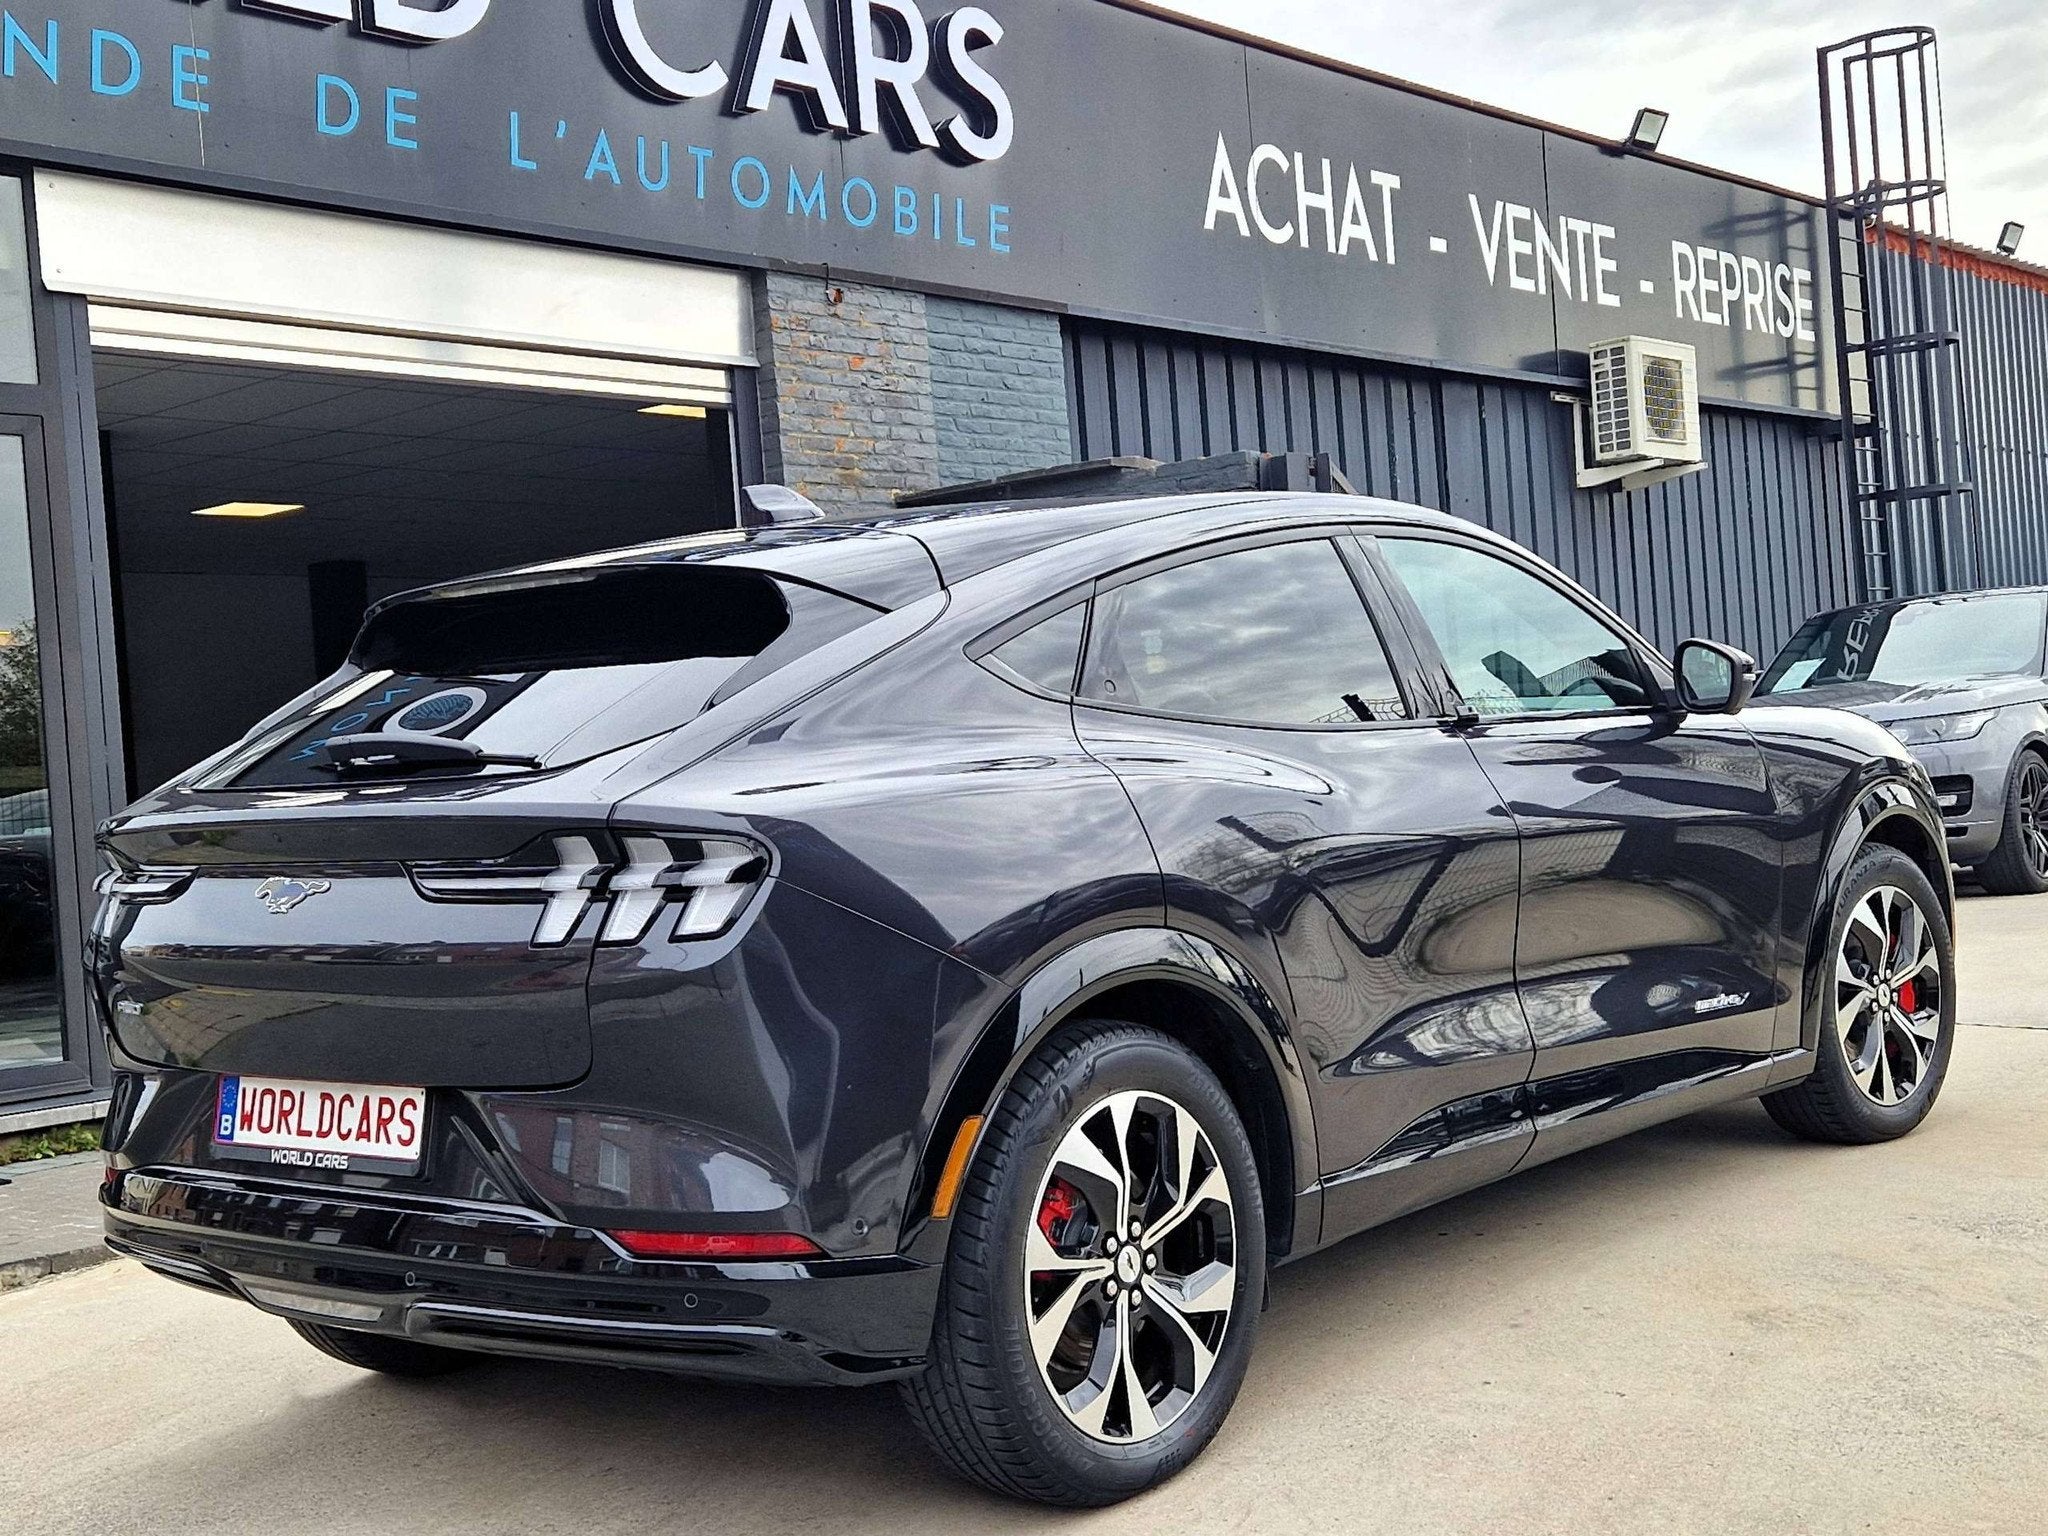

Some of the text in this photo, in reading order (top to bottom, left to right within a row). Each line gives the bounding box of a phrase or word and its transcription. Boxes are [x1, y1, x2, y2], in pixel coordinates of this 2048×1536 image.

[316, 74, 418, 149] DE
[1204, 131, 1401, 265] ACHAT
[1468, 193, 1621, 307] VENTE
[1672, 240, 1816, 342] REPRISE
[219, 1086, 418, 1147] B WORLDCARS
[270, 1149, 349, 1170] WORLD CARS
